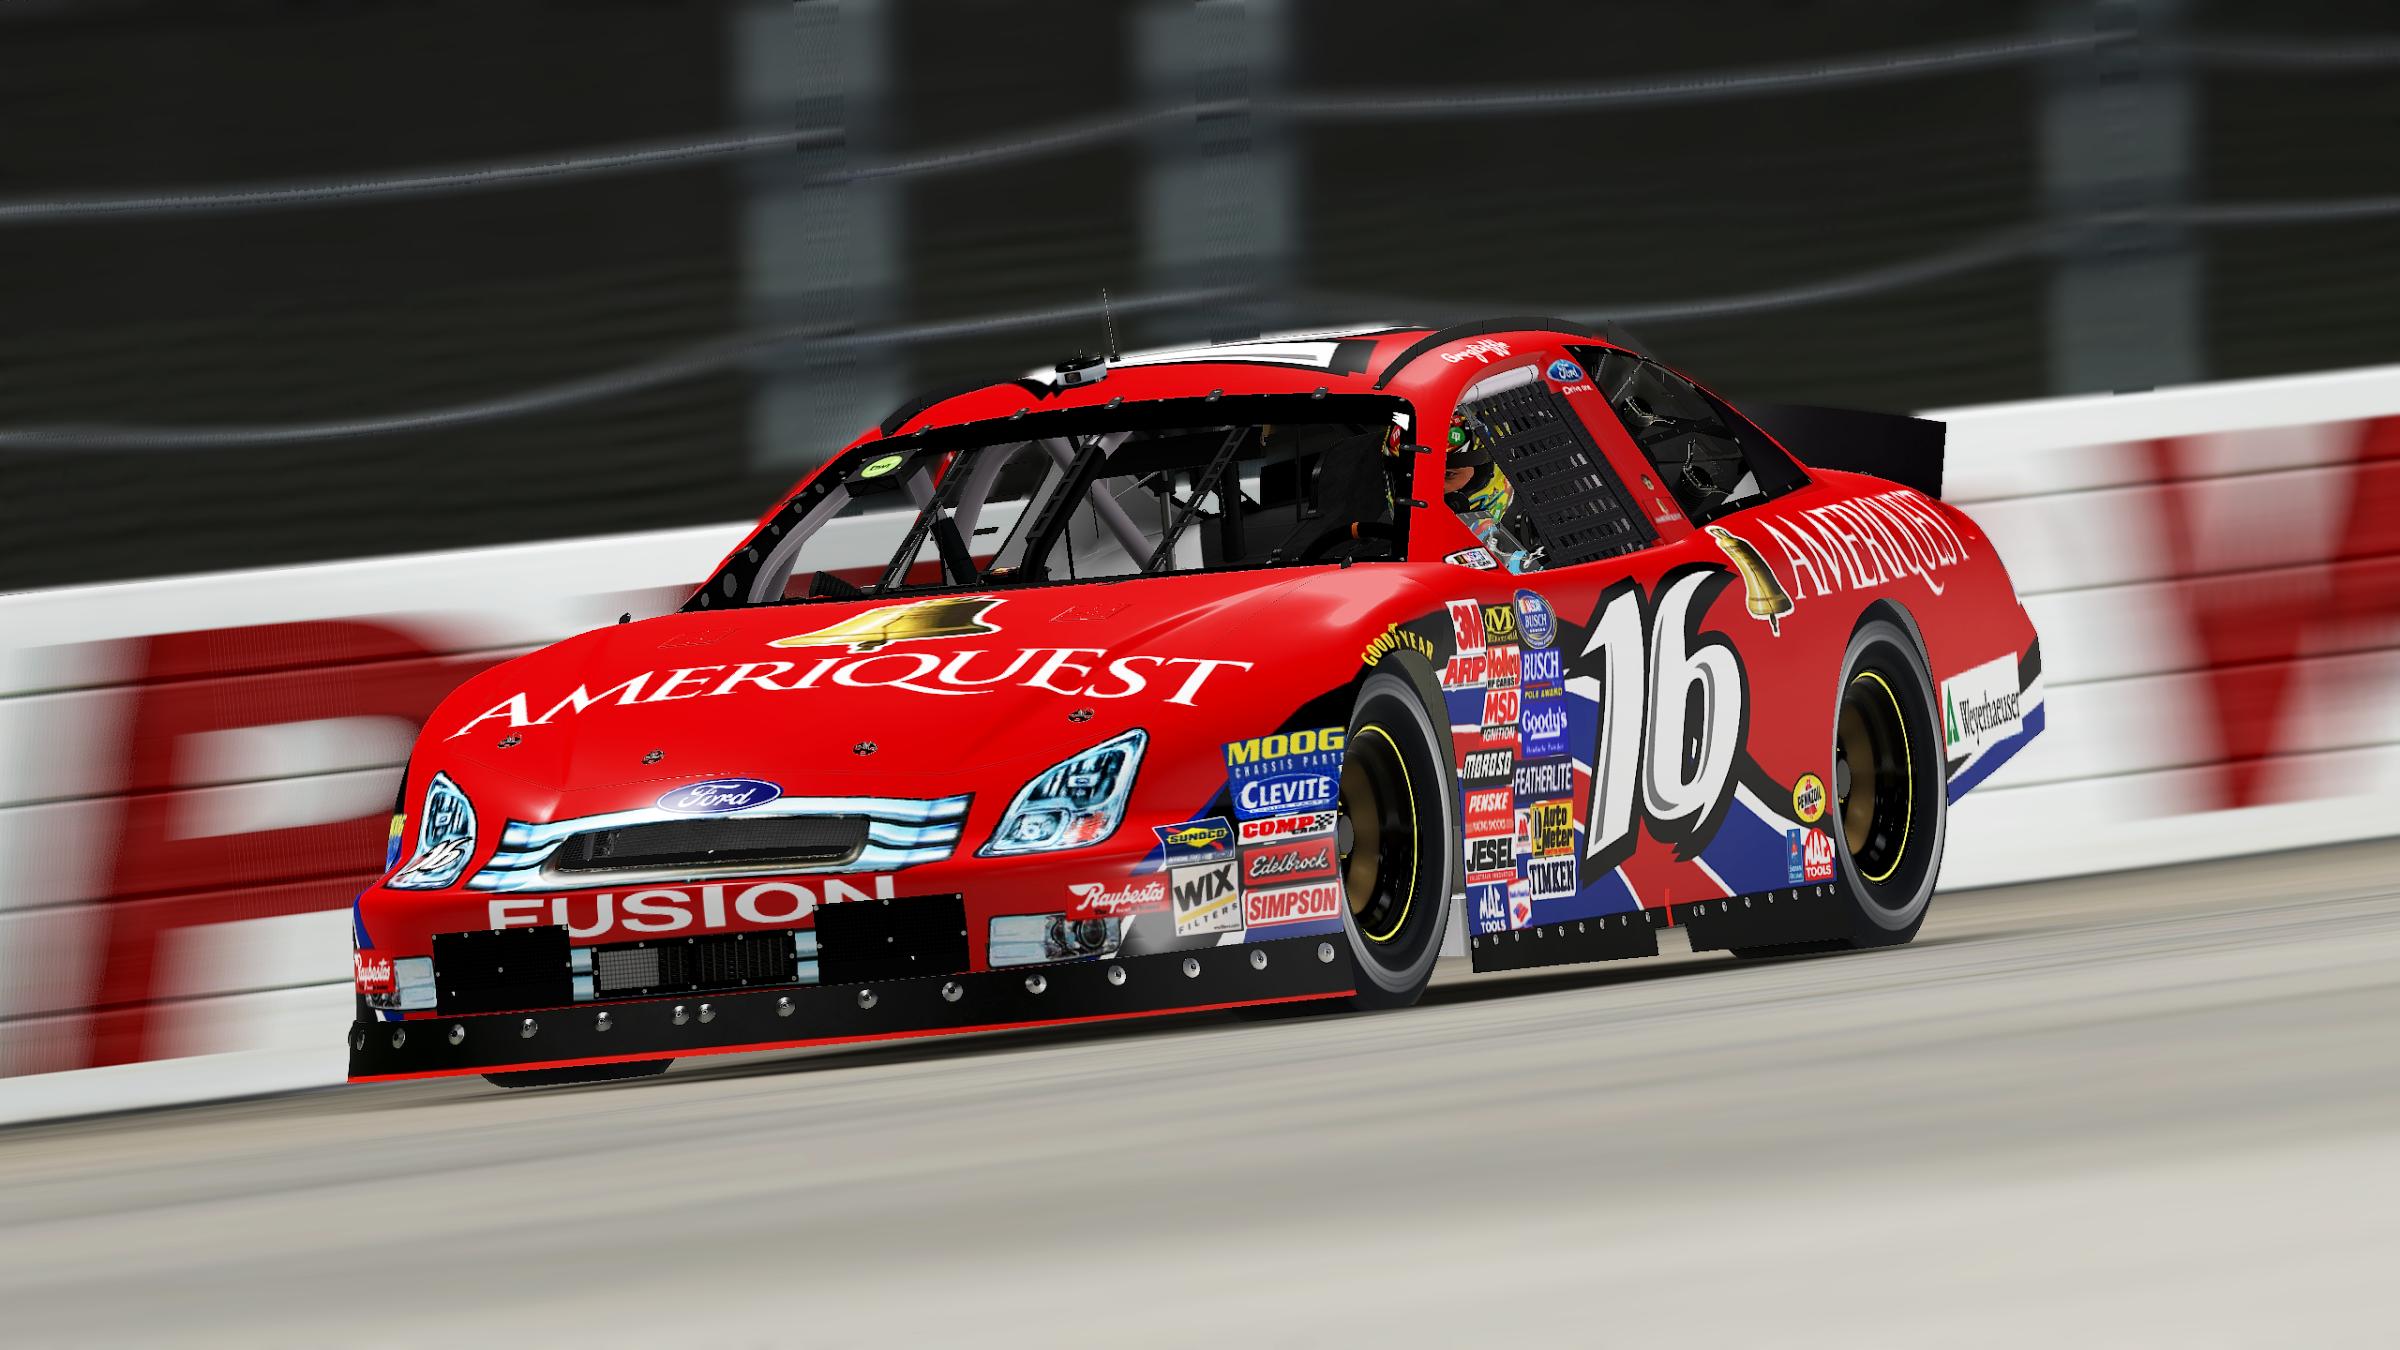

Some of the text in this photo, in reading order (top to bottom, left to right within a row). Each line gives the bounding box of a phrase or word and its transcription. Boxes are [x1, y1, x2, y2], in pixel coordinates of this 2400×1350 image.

[1558, 361, 1579, 379] Ford
[1756, 489, 1970, 600] AMERIQUEST
[1452, 604, 1485, 651] 3M
[1525, 614, 1547, 628] BUSCH
[1361, 622, 1434, 667] GOODYEAR
[1443, 656, 1487, 685] ARP
[1524, 651, 1559, 681] BUSCH
[442, 647, 1253, 740] AMERIQUEST
[1484, 691, 1518, 726] MSD
[1525, 687, 1562, 699] POLE AWARD
[1522, 706, 1567, 741] Goody's
[1580, 570, 1742, 860] 16
[1959, 689, 2020, 746] Weyerhaeuser
[1228, 727, 1345, 766] MOOG
[1483, 726, 1515, 742] IGNITION
[1235, 759, 1293, 779] CHASSIS
[1463, 751, 1512, 779] MOROSO
[1515, 762, 1572, 795] FEATHERLITE
[678, 784, 757, 808] Ford
[1241, 777, 1331, 809] CLEVITE
[1469, 792, 1509, 813] PENSKE
[1797, 785, 1822, 812] PENNZOIL
[1242, 815, 1315, 839] COMP
[1543, 806, 1567, 827] Auto
[1169, 829, 1225, 843] SUNOCO
[1542, 827, 1573, 848] Meter
[1805, 831, 1831, 866] MAC
[1250, 847, 1329, 878] Edelbrock
[1467, 838, 1516, 872] JESEL
[1806, 864, 1831, 878] TOOLS
[1174, 864, 1235, 912] WIX
[1529, 860, 1575, 895] TIMKEN
[1068, 881, 1166, 914] Raybestos
[1250, 887, 1337, 921] SIMPSON
[1480, 884, 1504, 919] MAC
[1178, 902, 1239, 935] FILTERS
[1481, 919, 1507, 933] TOOLS
